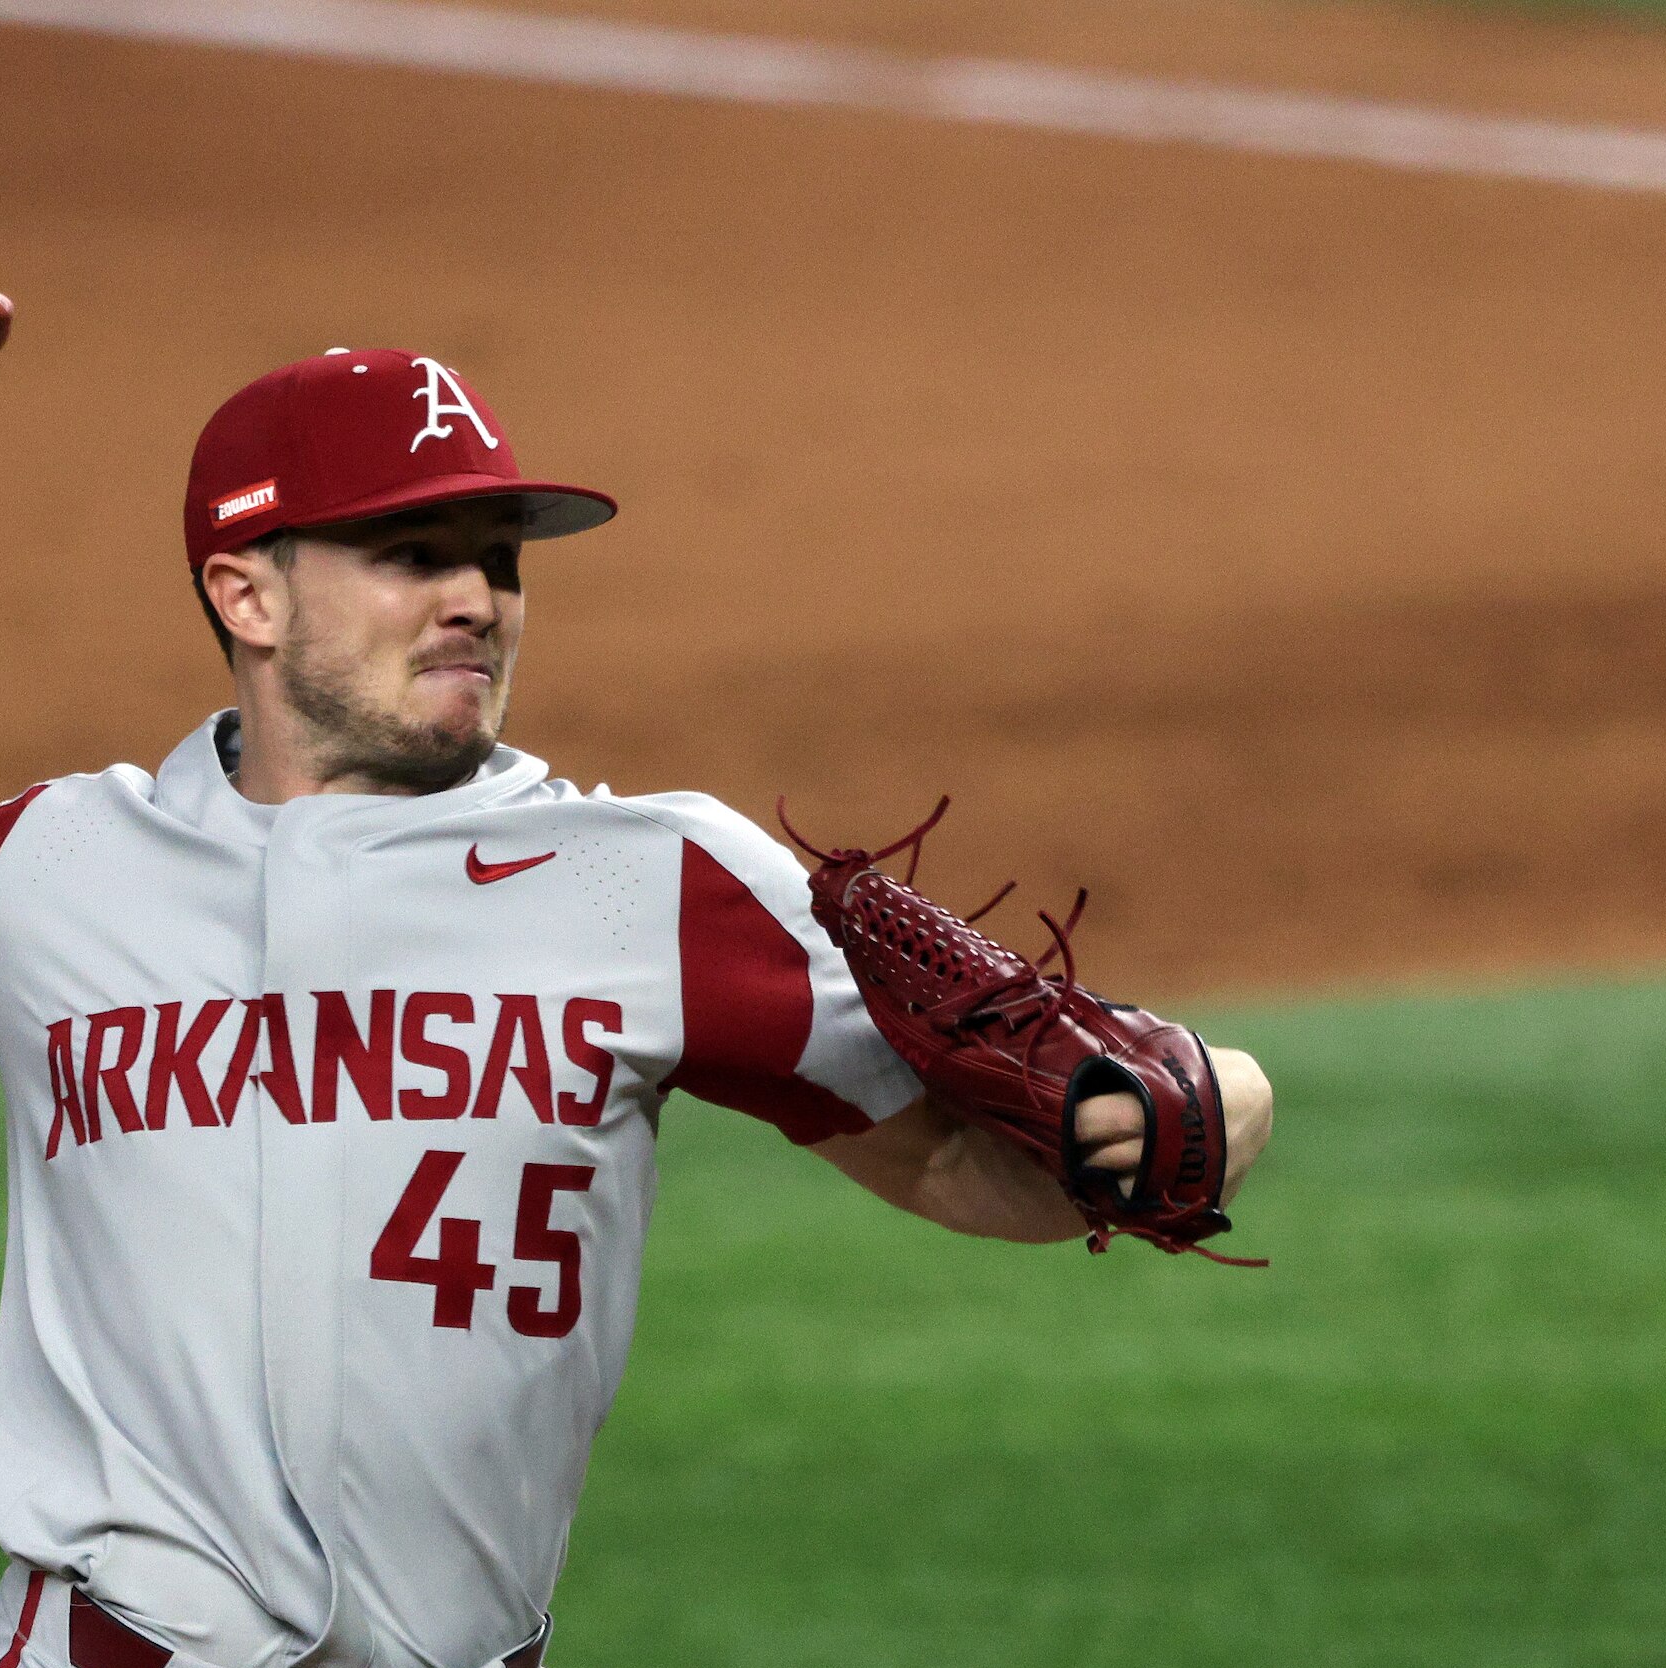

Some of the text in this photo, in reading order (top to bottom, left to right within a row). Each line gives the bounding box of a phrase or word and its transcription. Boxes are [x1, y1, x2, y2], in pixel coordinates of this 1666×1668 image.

[410, 357, 499, 453] A
[217, 485, 275, 520] EQUALITY
[45, 989, 623, 1160] ARKANSAS
[370, 1149, 595, 1339] 45
